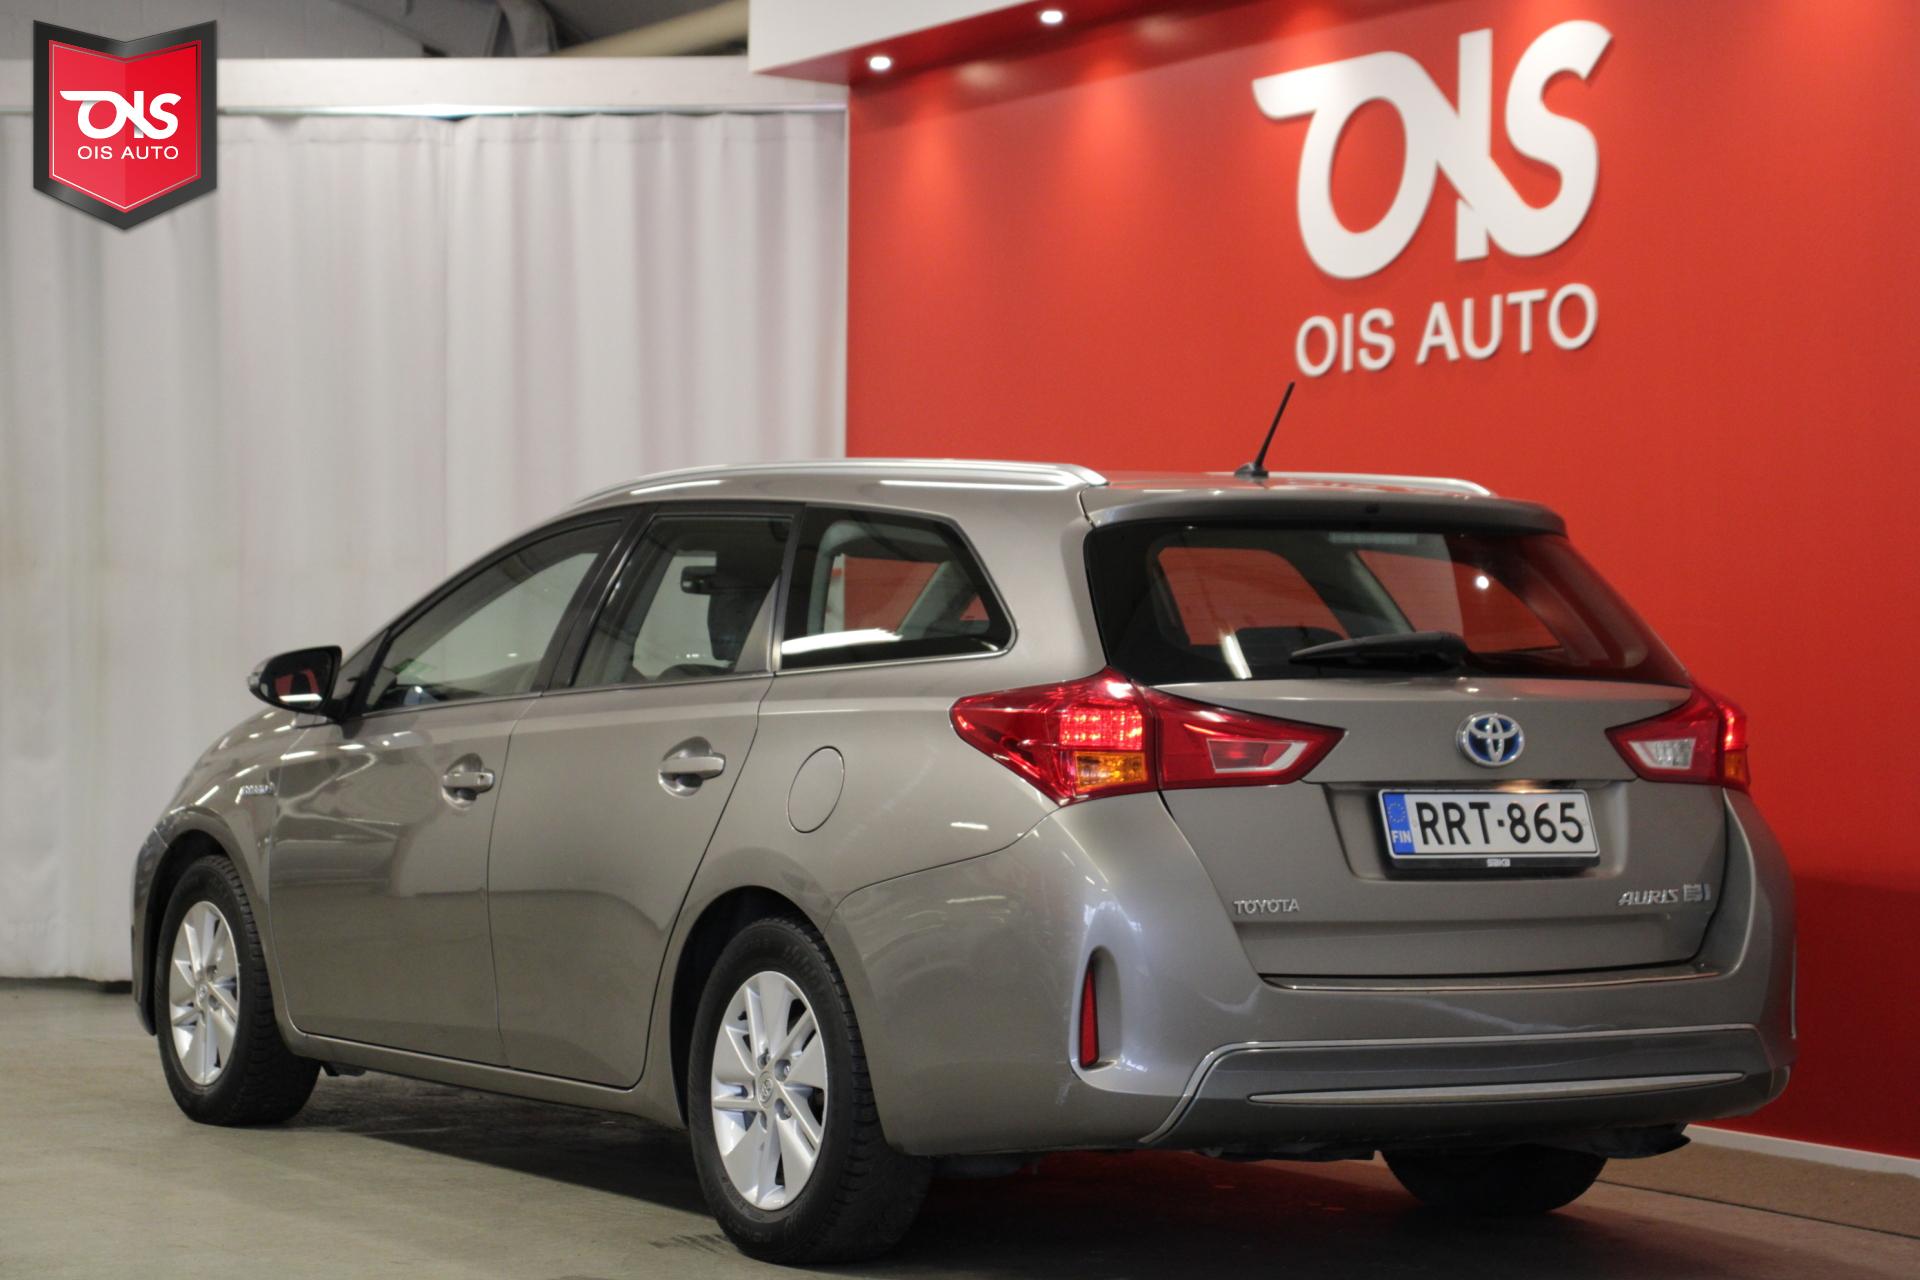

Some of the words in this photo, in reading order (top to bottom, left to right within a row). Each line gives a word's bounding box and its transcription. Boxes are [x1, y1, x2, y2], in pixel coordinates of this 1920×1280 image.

[1295, 308, 1395, 377] OIS
[1416, 283, 1598, 364] AUTO
[1415, 801, 1584, 845] RRT-865
[1391, 830, 1412, 843] FIN
[1233, 898, 1299, 914] TOYOTA
[1618, 888, 1680, 906] AURIS
